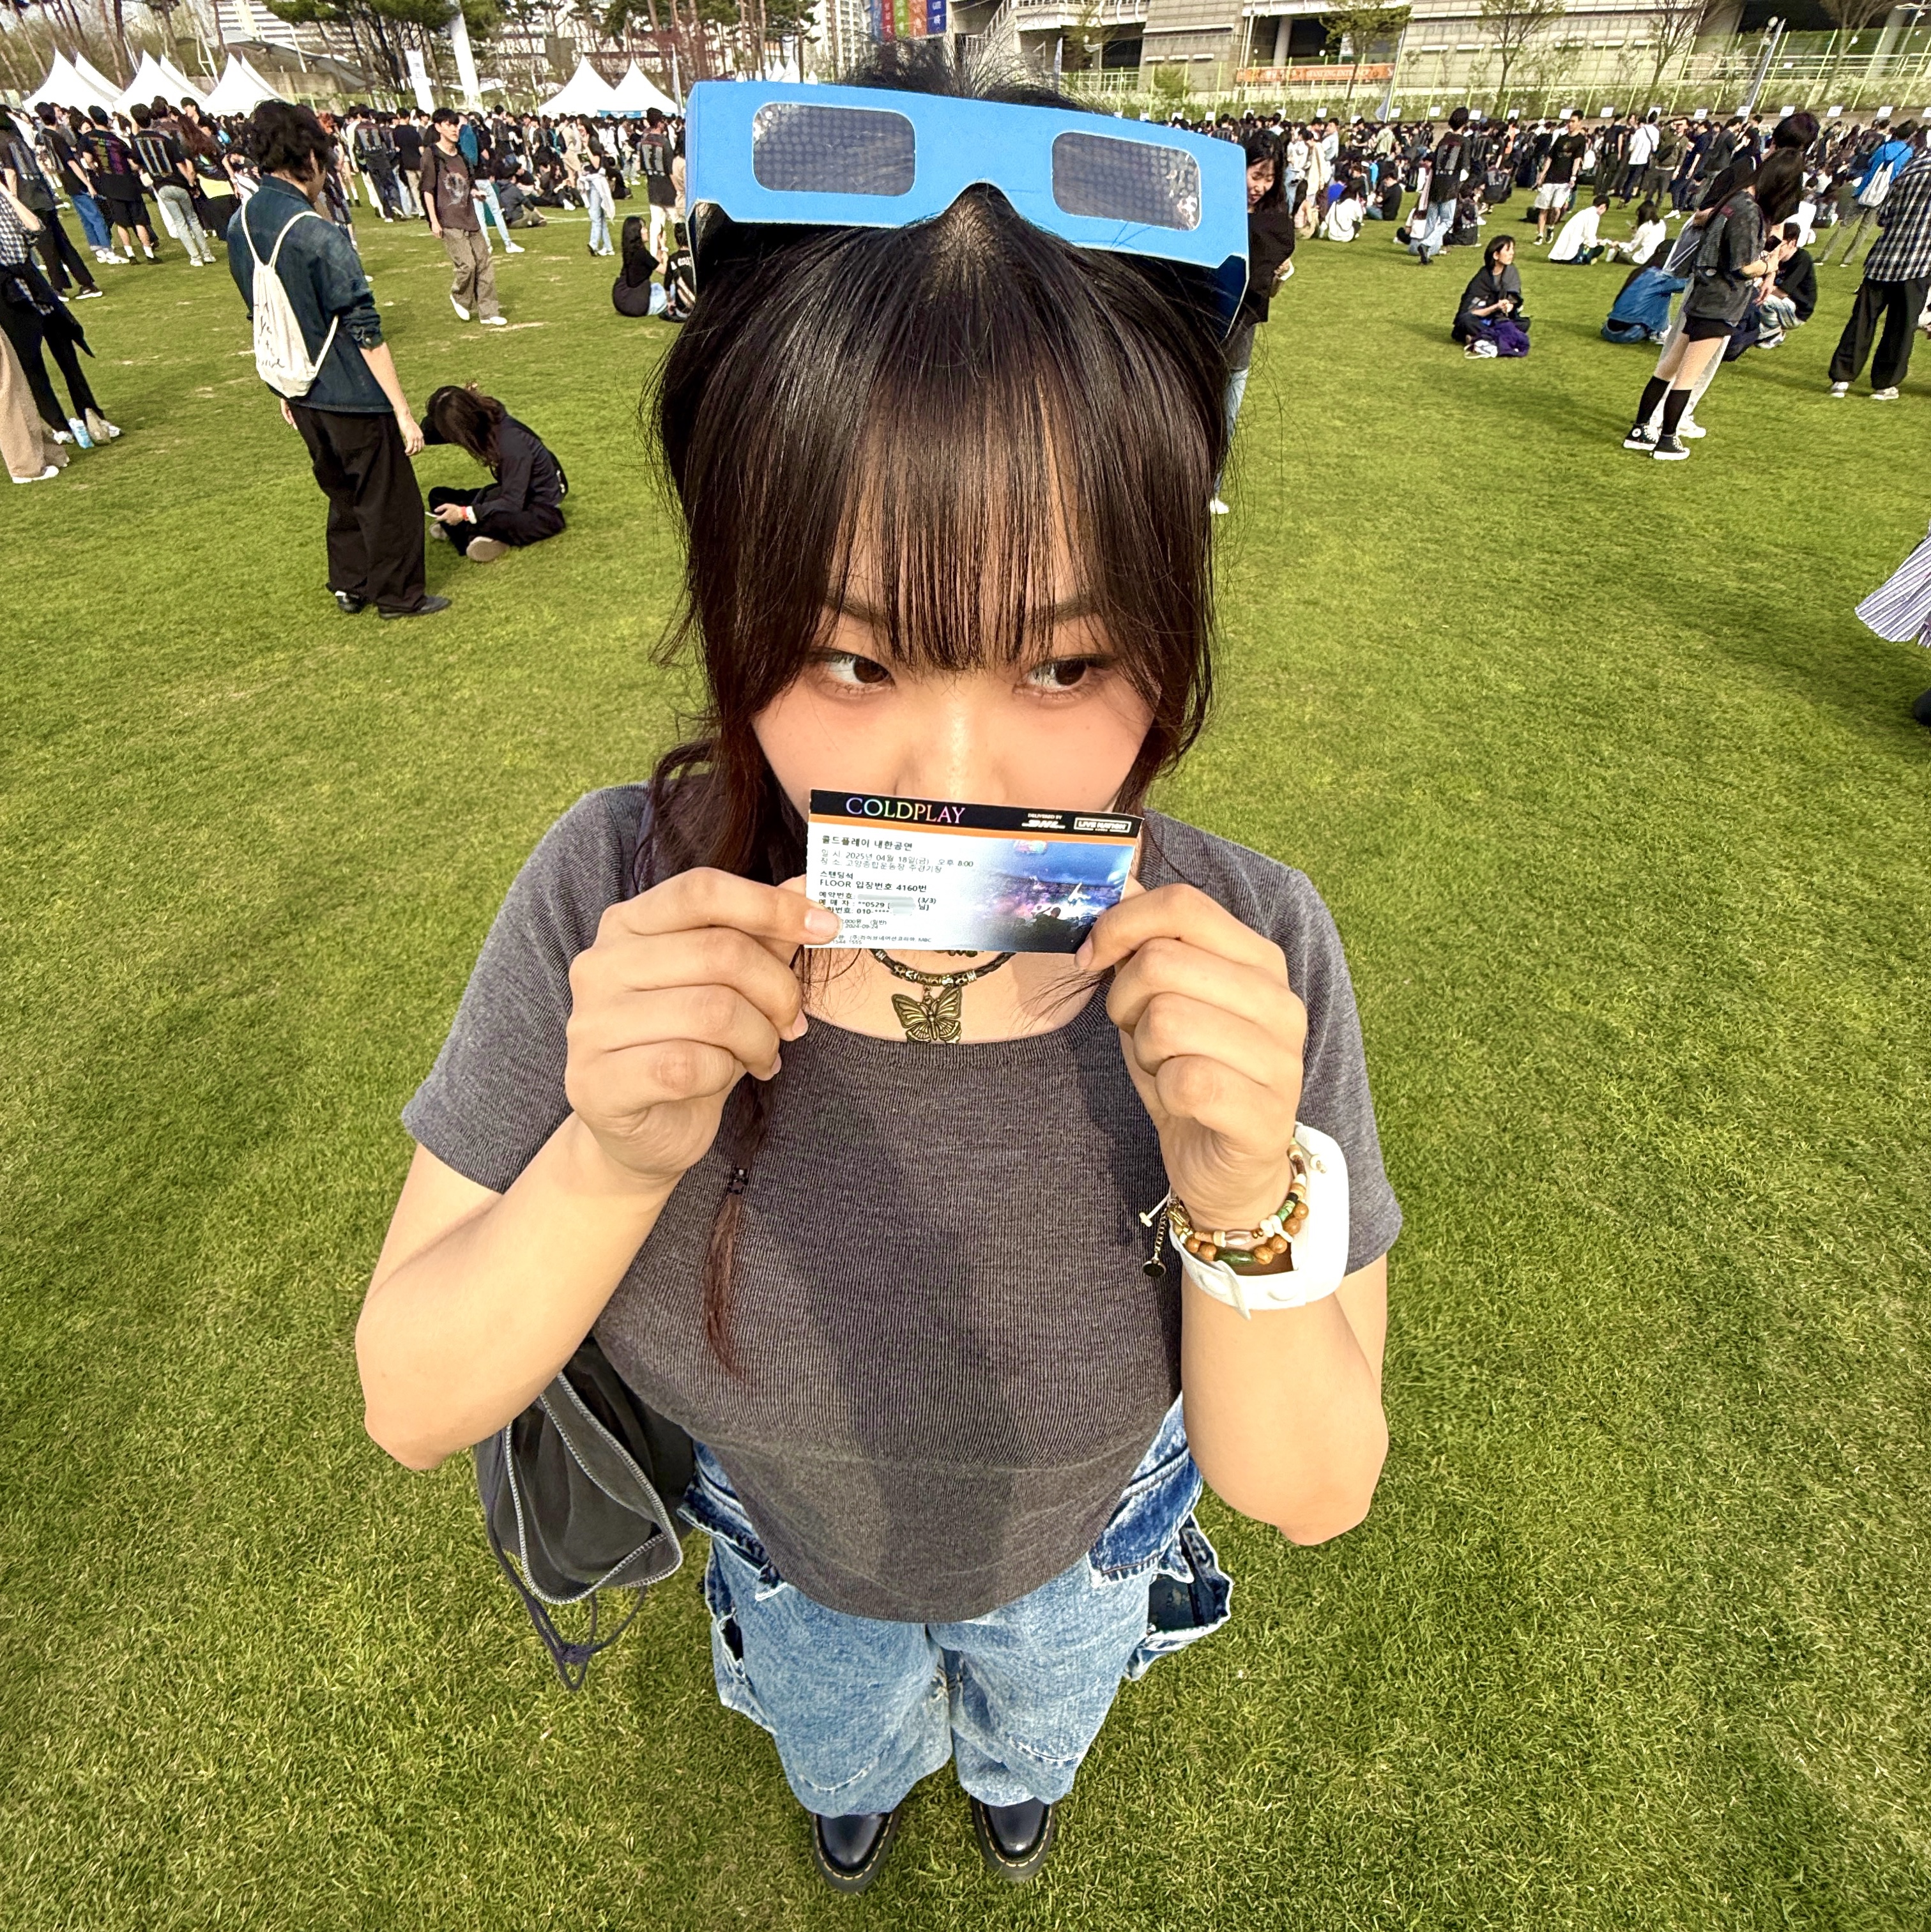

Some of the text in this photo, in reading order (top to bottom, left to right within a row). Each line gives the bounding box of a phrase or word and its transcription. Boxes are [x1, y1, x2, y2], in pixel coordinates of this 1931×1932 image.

[846, 797, 965, 824] COLDPLAY
[1025, 819, 1063, 829] DHL
[822, 835, 912, 851] 콜드플레이 내한공연
[846, 852, 873, 861] 2025년
[899, 856, 929, 865] 18일(금)
[846, 860, 904, 871] 고양종합운동장
[820, 879, 851, 888] FLOOR
[856, 881, 892, 890] 입장번호
